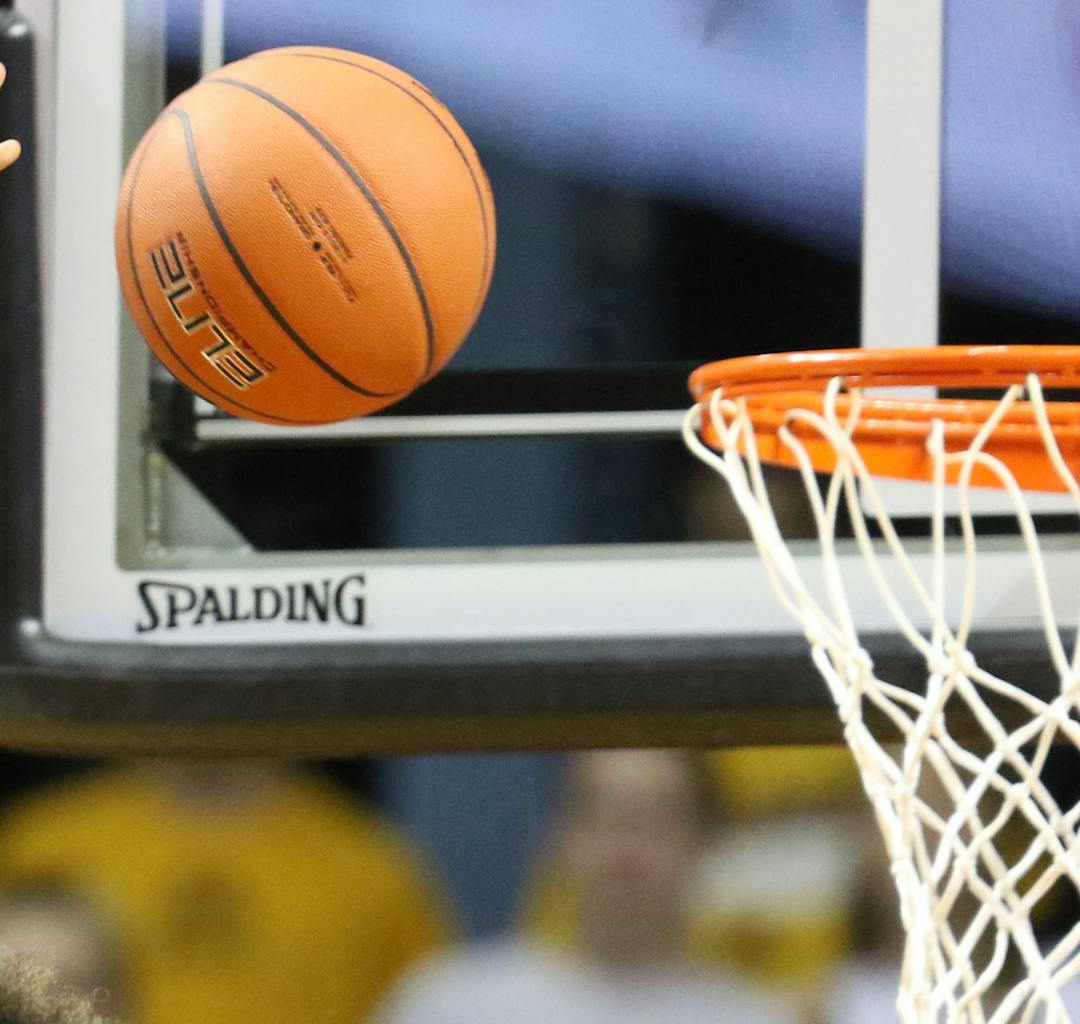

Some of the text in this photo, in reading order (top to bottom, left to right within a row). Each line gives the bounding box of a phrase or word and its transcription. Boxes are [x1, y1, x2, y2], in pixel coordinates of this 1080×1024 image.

[149, 238, 268, 391] ELITE
[176, 231, 277, 372] CHAMPIONSHIP
[135, 573, 367, 633] SPALDING
